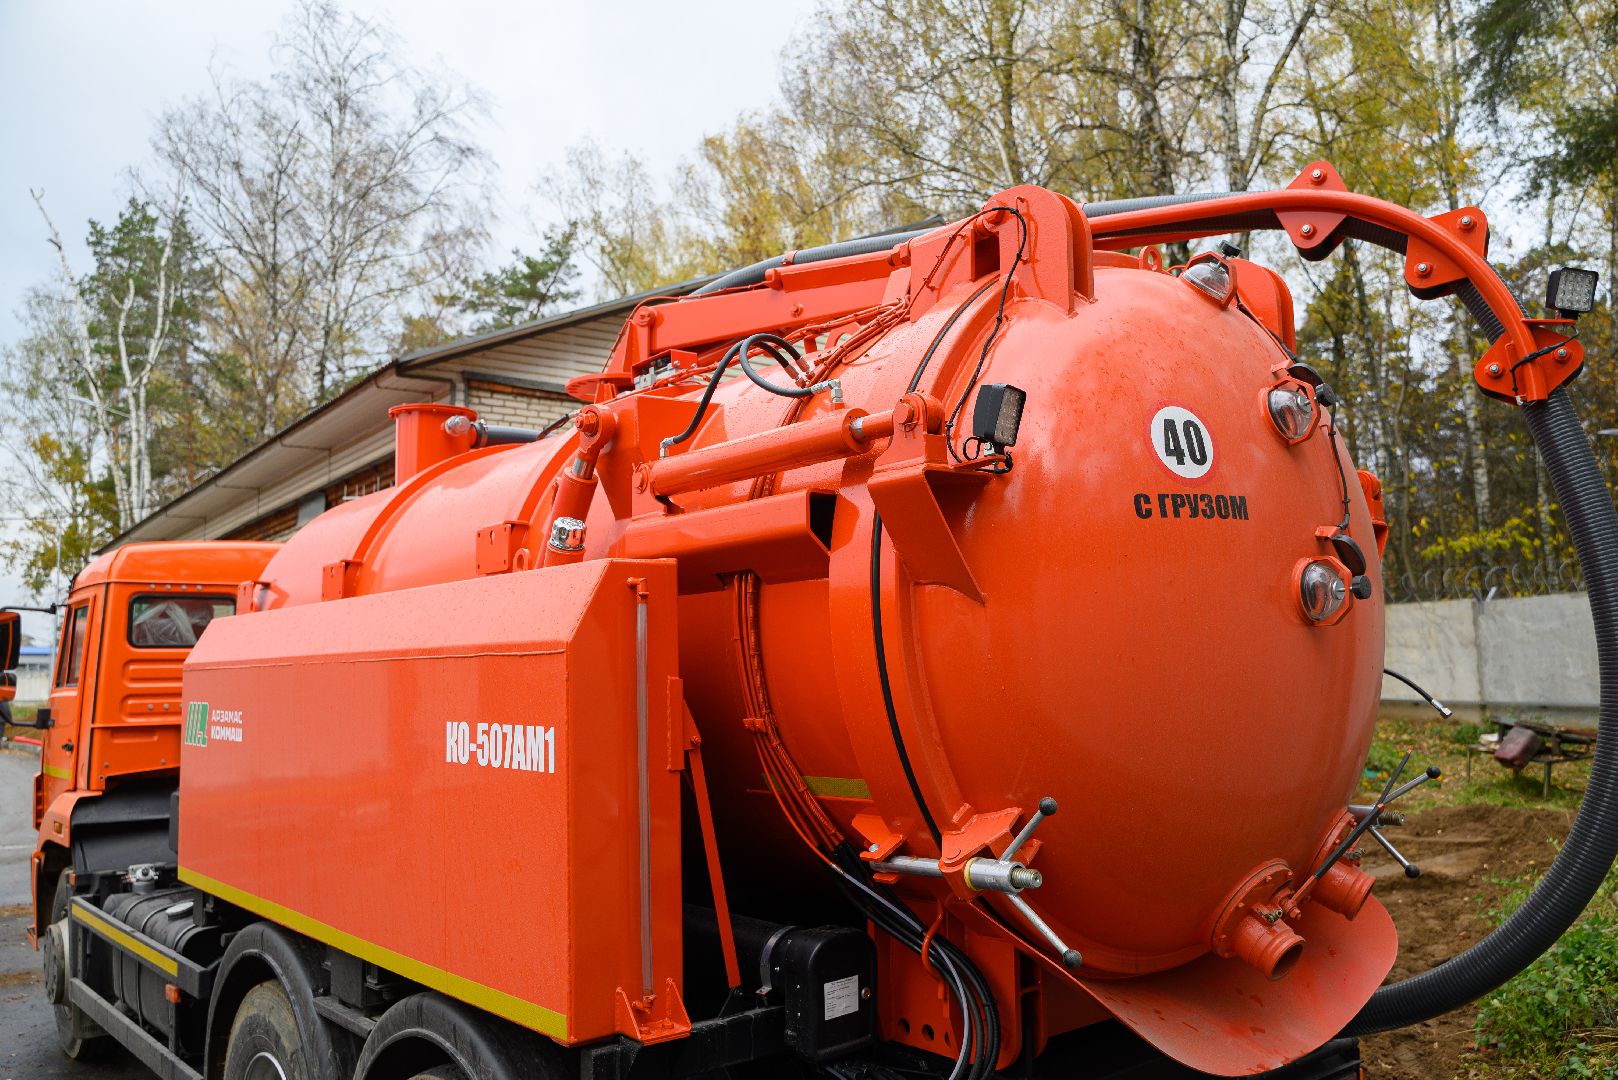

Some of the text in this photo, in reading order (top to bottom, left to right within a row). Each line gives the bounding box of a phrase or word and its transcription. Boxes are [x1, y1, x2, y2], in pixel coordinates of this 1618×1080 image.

[1164, 419, 1207, 466] 40
[1134, 493, 1249, 520] С ГРУЗОМ
[212, 710, 242, 724] АРЗАМАС
[211, 726, 242, 742] КОММАШ
[446, 721, 555, 774] КО-507АМ1
